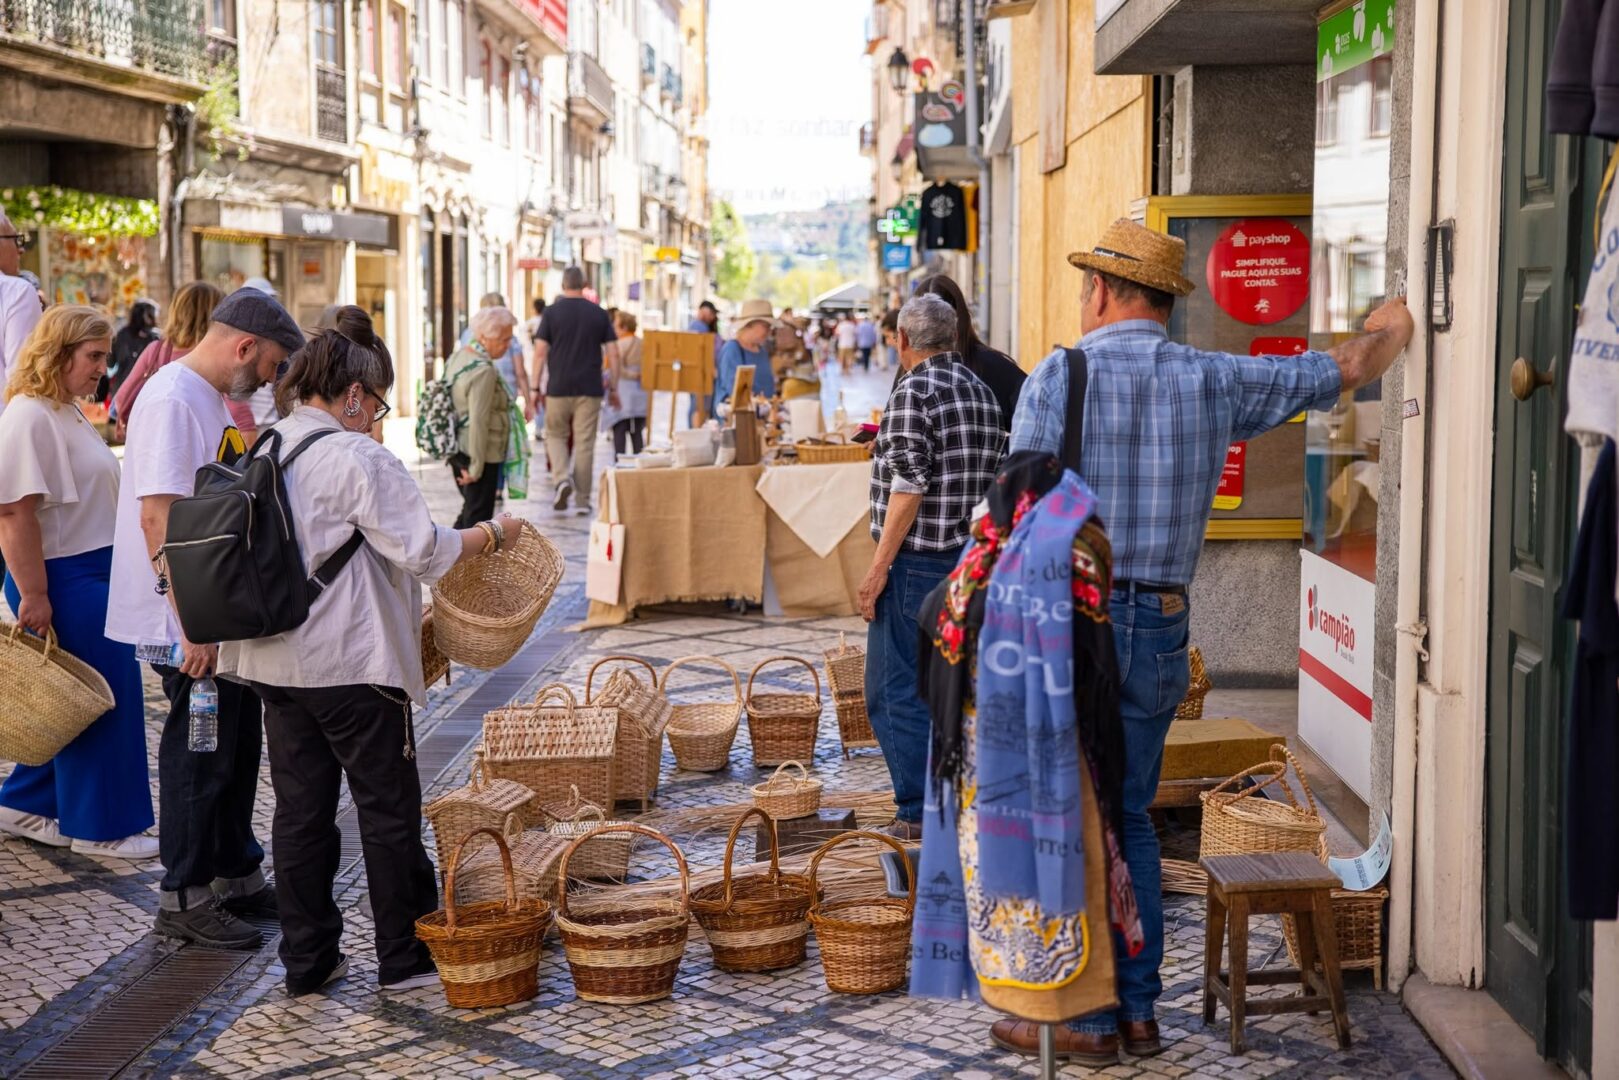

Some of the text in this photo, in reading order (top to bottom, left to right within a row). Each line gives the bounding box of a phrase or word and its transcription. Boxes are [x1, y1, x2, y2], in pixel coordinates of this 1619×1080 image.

[1249, 234, 1290, 247] payshop
[1236, 258, 1287, 267] SIMPLIFIQUE.
[1221, 267, 1301, 278] PAGUE AQUI AS SUAS
[1244, 279, 1278, 288] CONTAS.
[1320, 610, 1355, 653] campião
